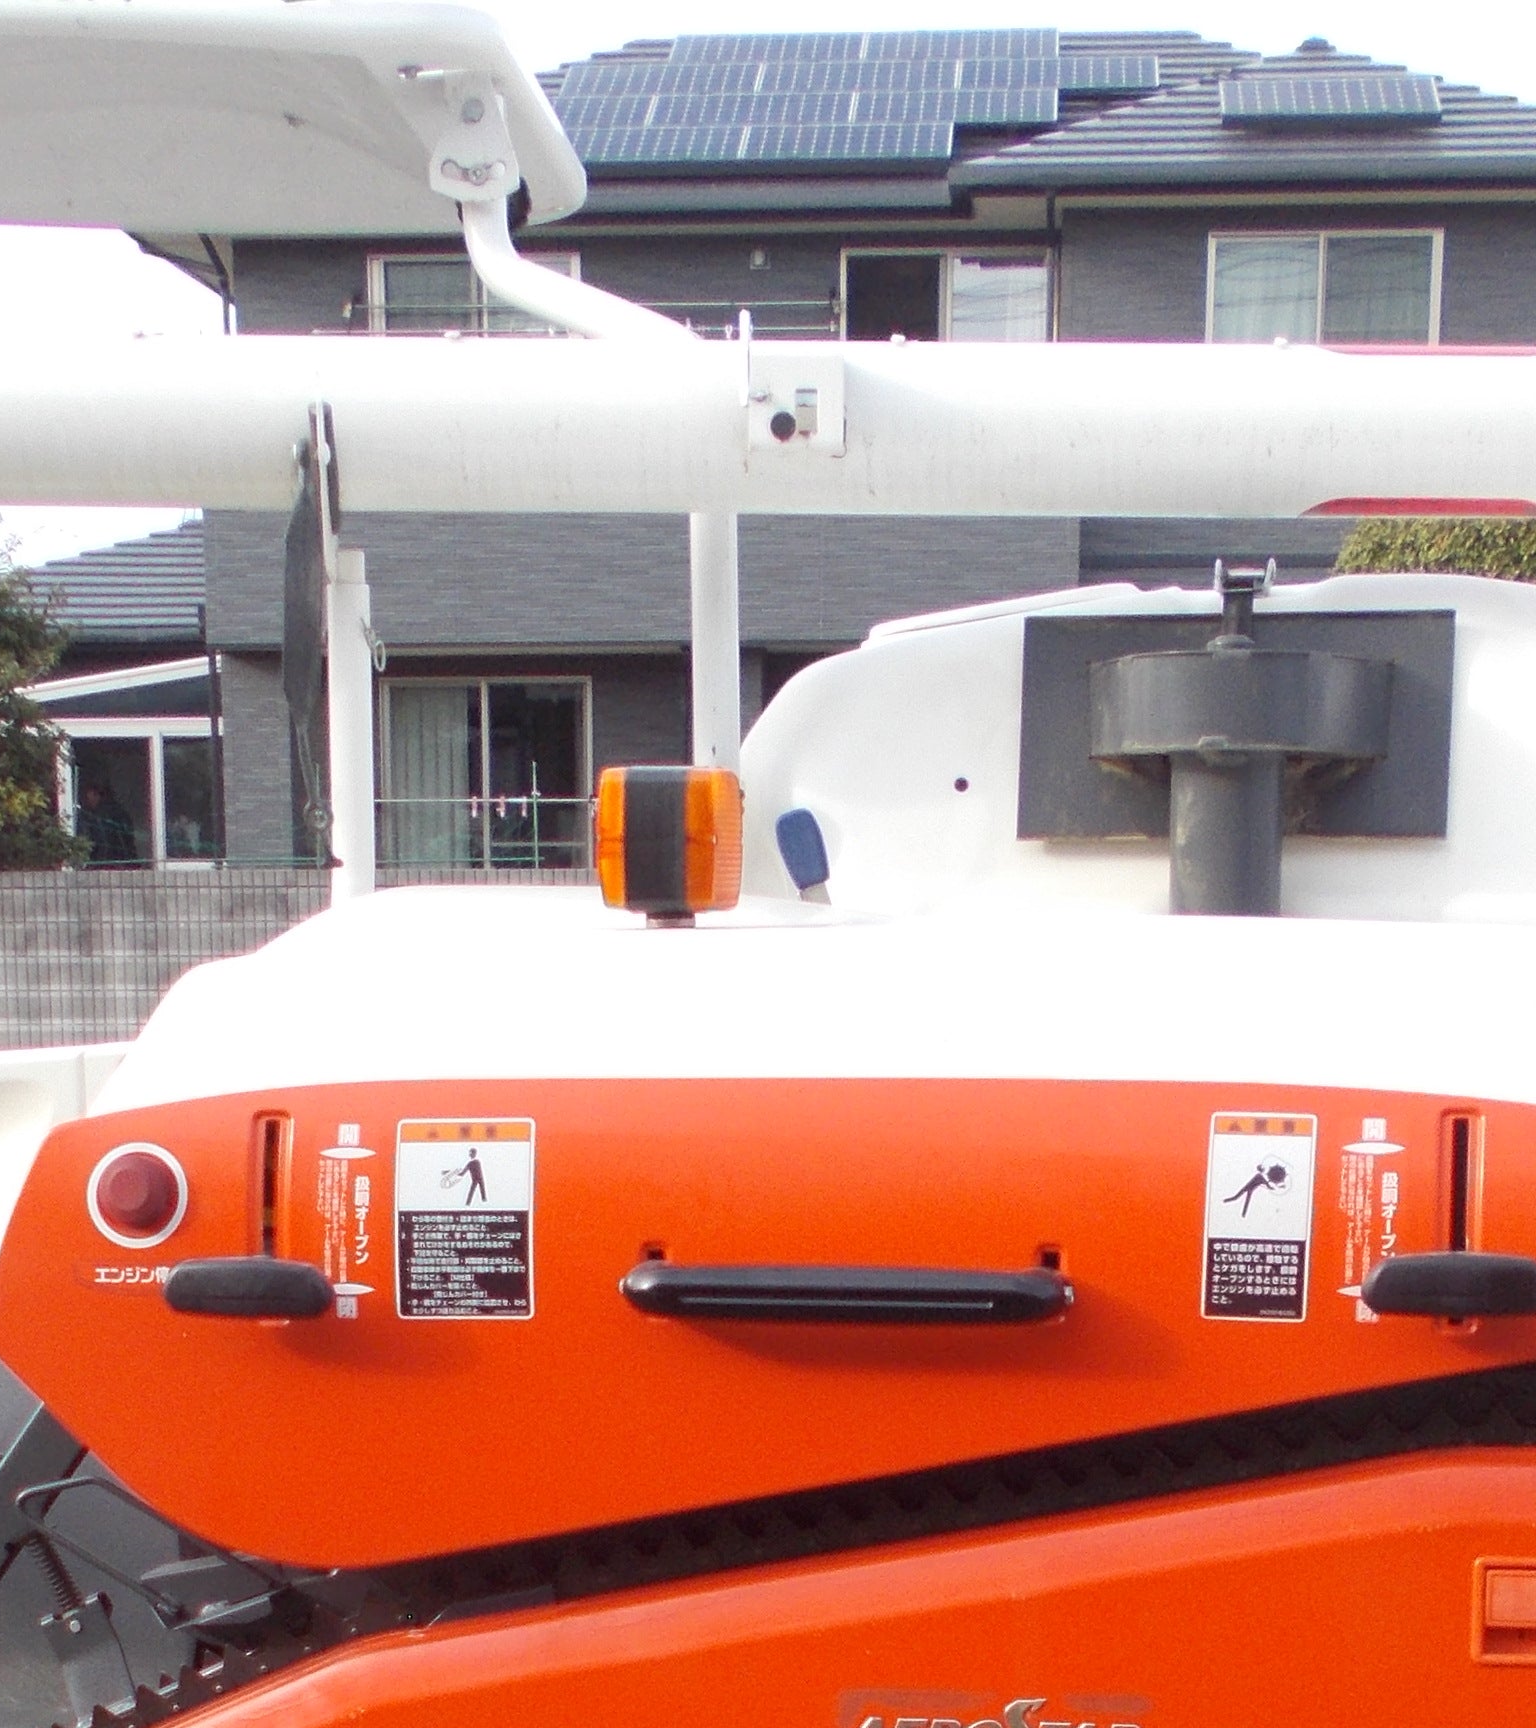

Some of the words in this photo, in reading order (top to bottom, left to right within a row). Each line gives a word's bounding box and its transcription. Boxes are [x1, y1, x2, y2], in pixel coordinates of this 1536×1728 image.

[1381, 1172, 1399, 1257] 扱胴オープ
[94, 1265, 170, 1284] エンジン停
[1212, 1275, 1296, 1285] オープンするときには
[1212, 1285, 1296, 1295] エンジンを必ず止める
[1212, 1296, 1232, 1304] こと。
